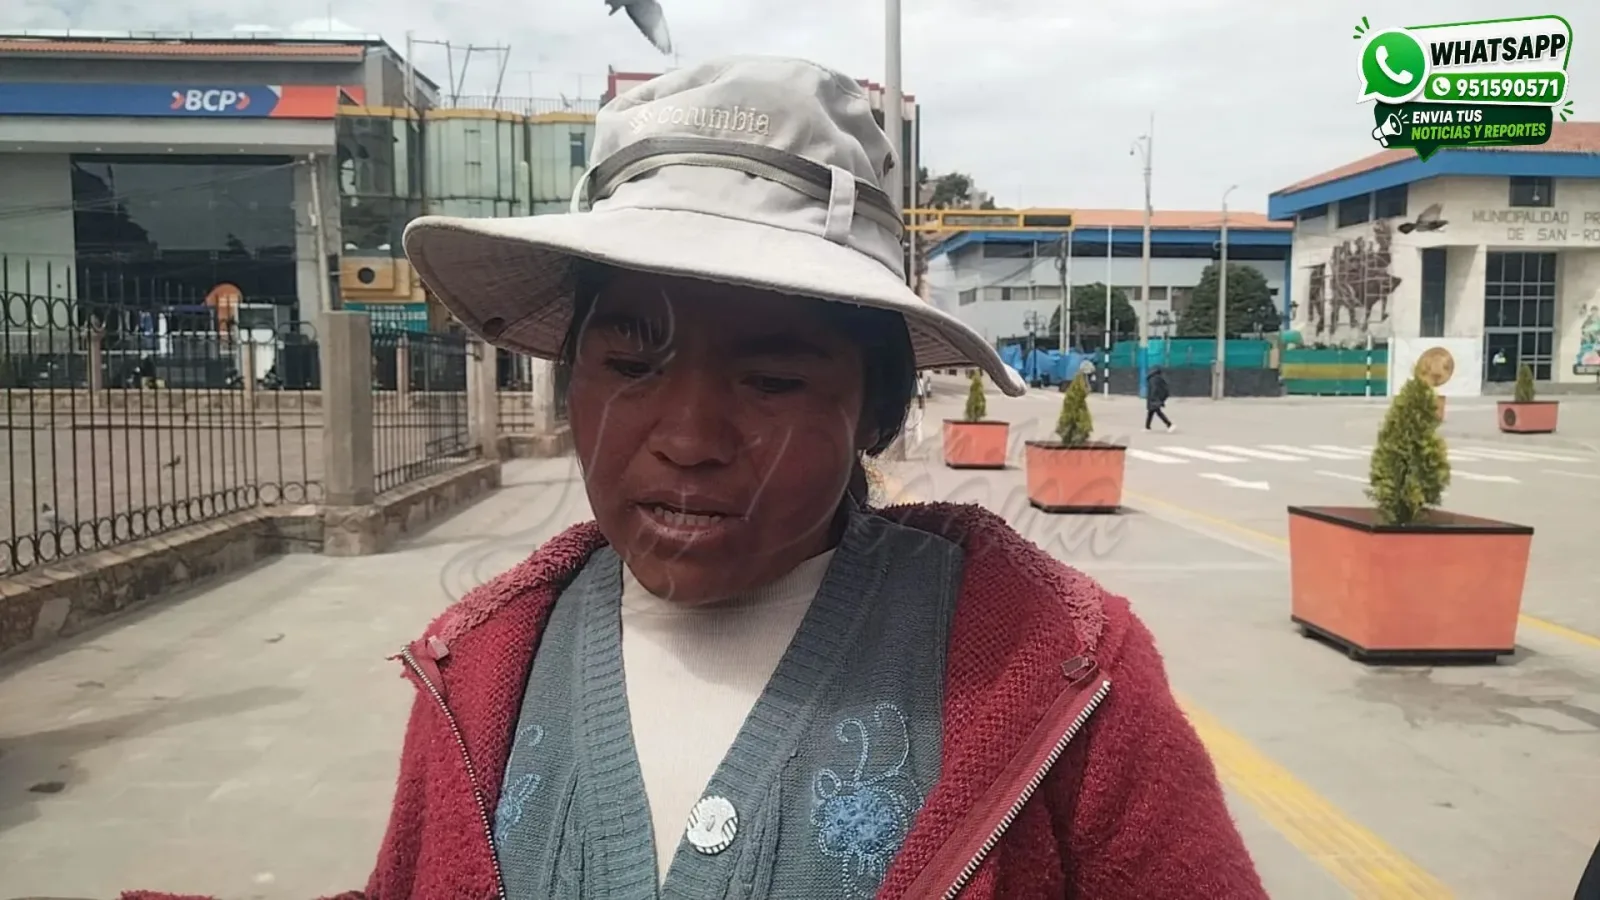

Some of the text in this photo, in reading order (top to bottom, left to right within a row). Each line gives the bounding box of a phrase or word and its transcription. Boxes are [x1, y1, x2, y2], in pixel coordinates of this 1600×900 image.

[185, 89, 237, 112] BCP
[1472, 208, 1569, 225] MUNICIPALIDAD
[1507, 227, 1525, 241] DE
